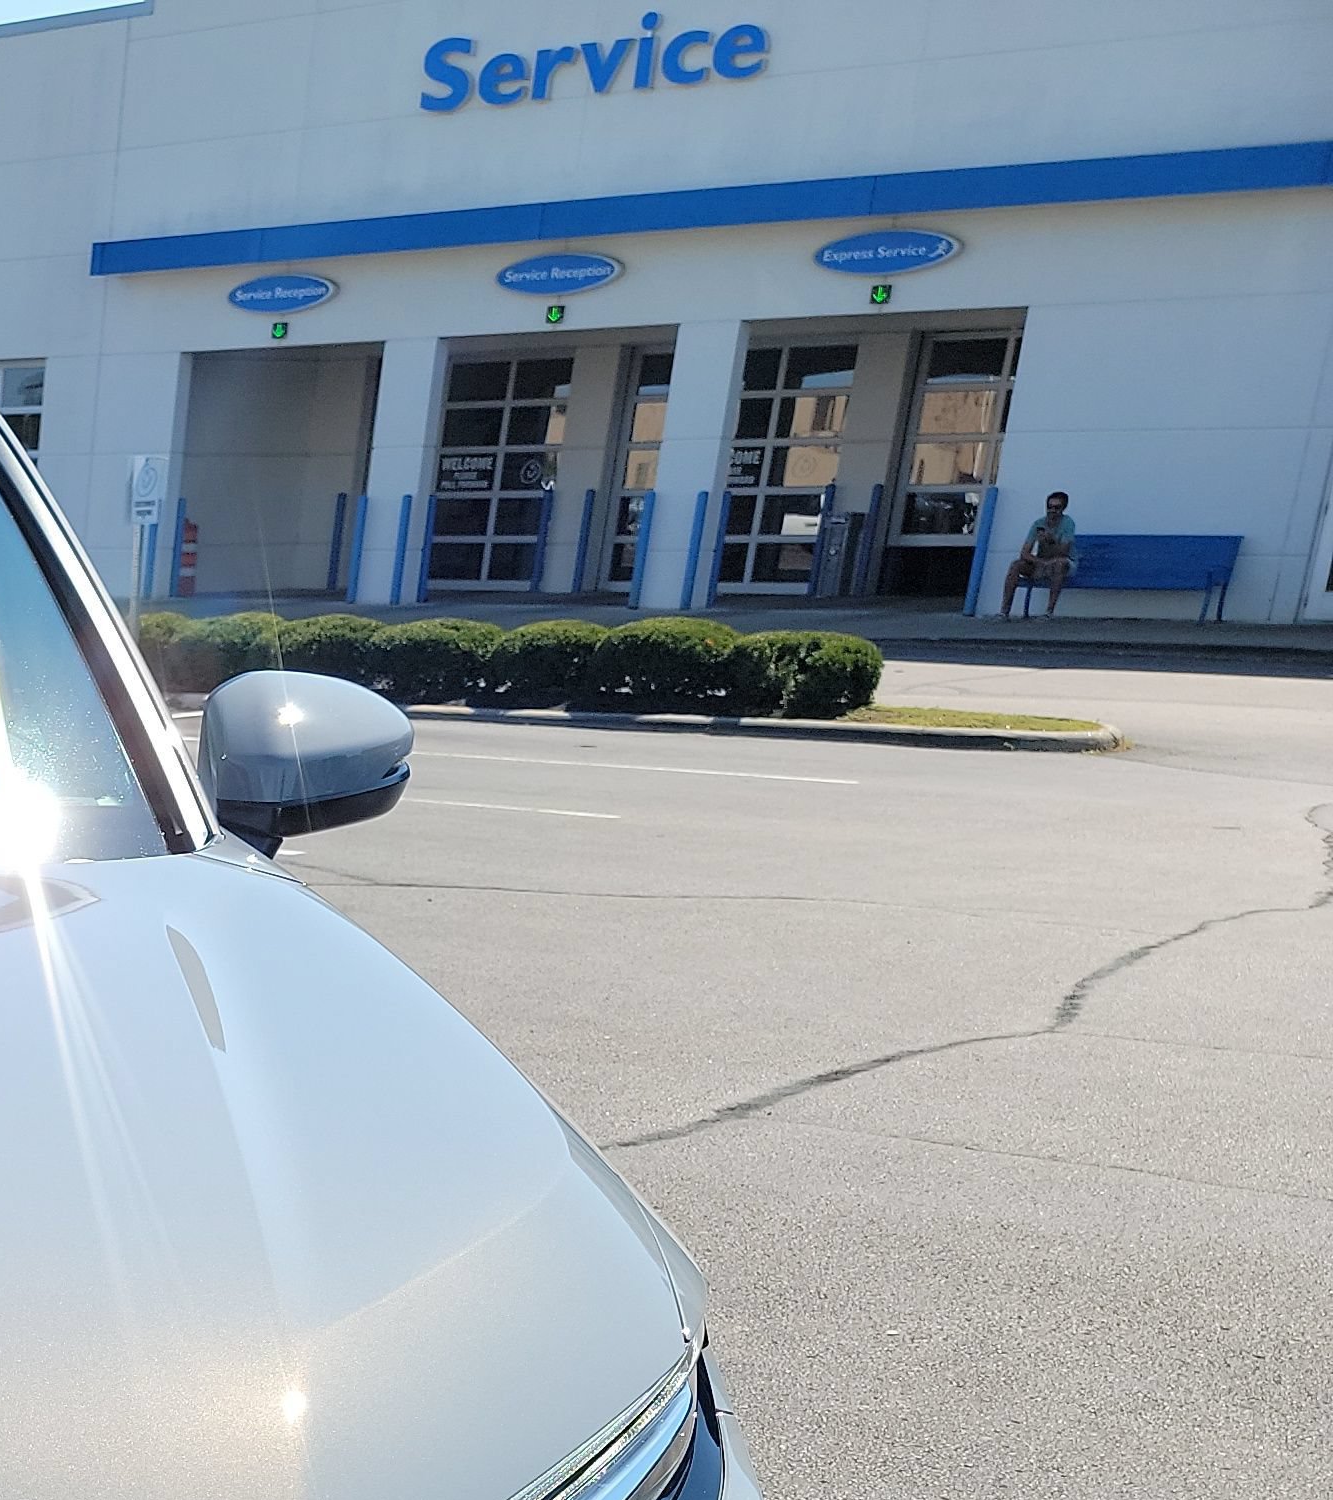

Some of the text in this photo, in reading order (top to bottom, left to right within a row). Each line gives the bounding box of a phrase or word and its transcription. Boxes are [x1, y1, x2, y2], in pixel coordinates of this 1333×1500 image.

[420, 11, 772, 113] Service
[823, 244, 926, 263] Express Service
[504, 264, 611, 283] Service Reception
[235, 286, 326, 302] Service Reception
